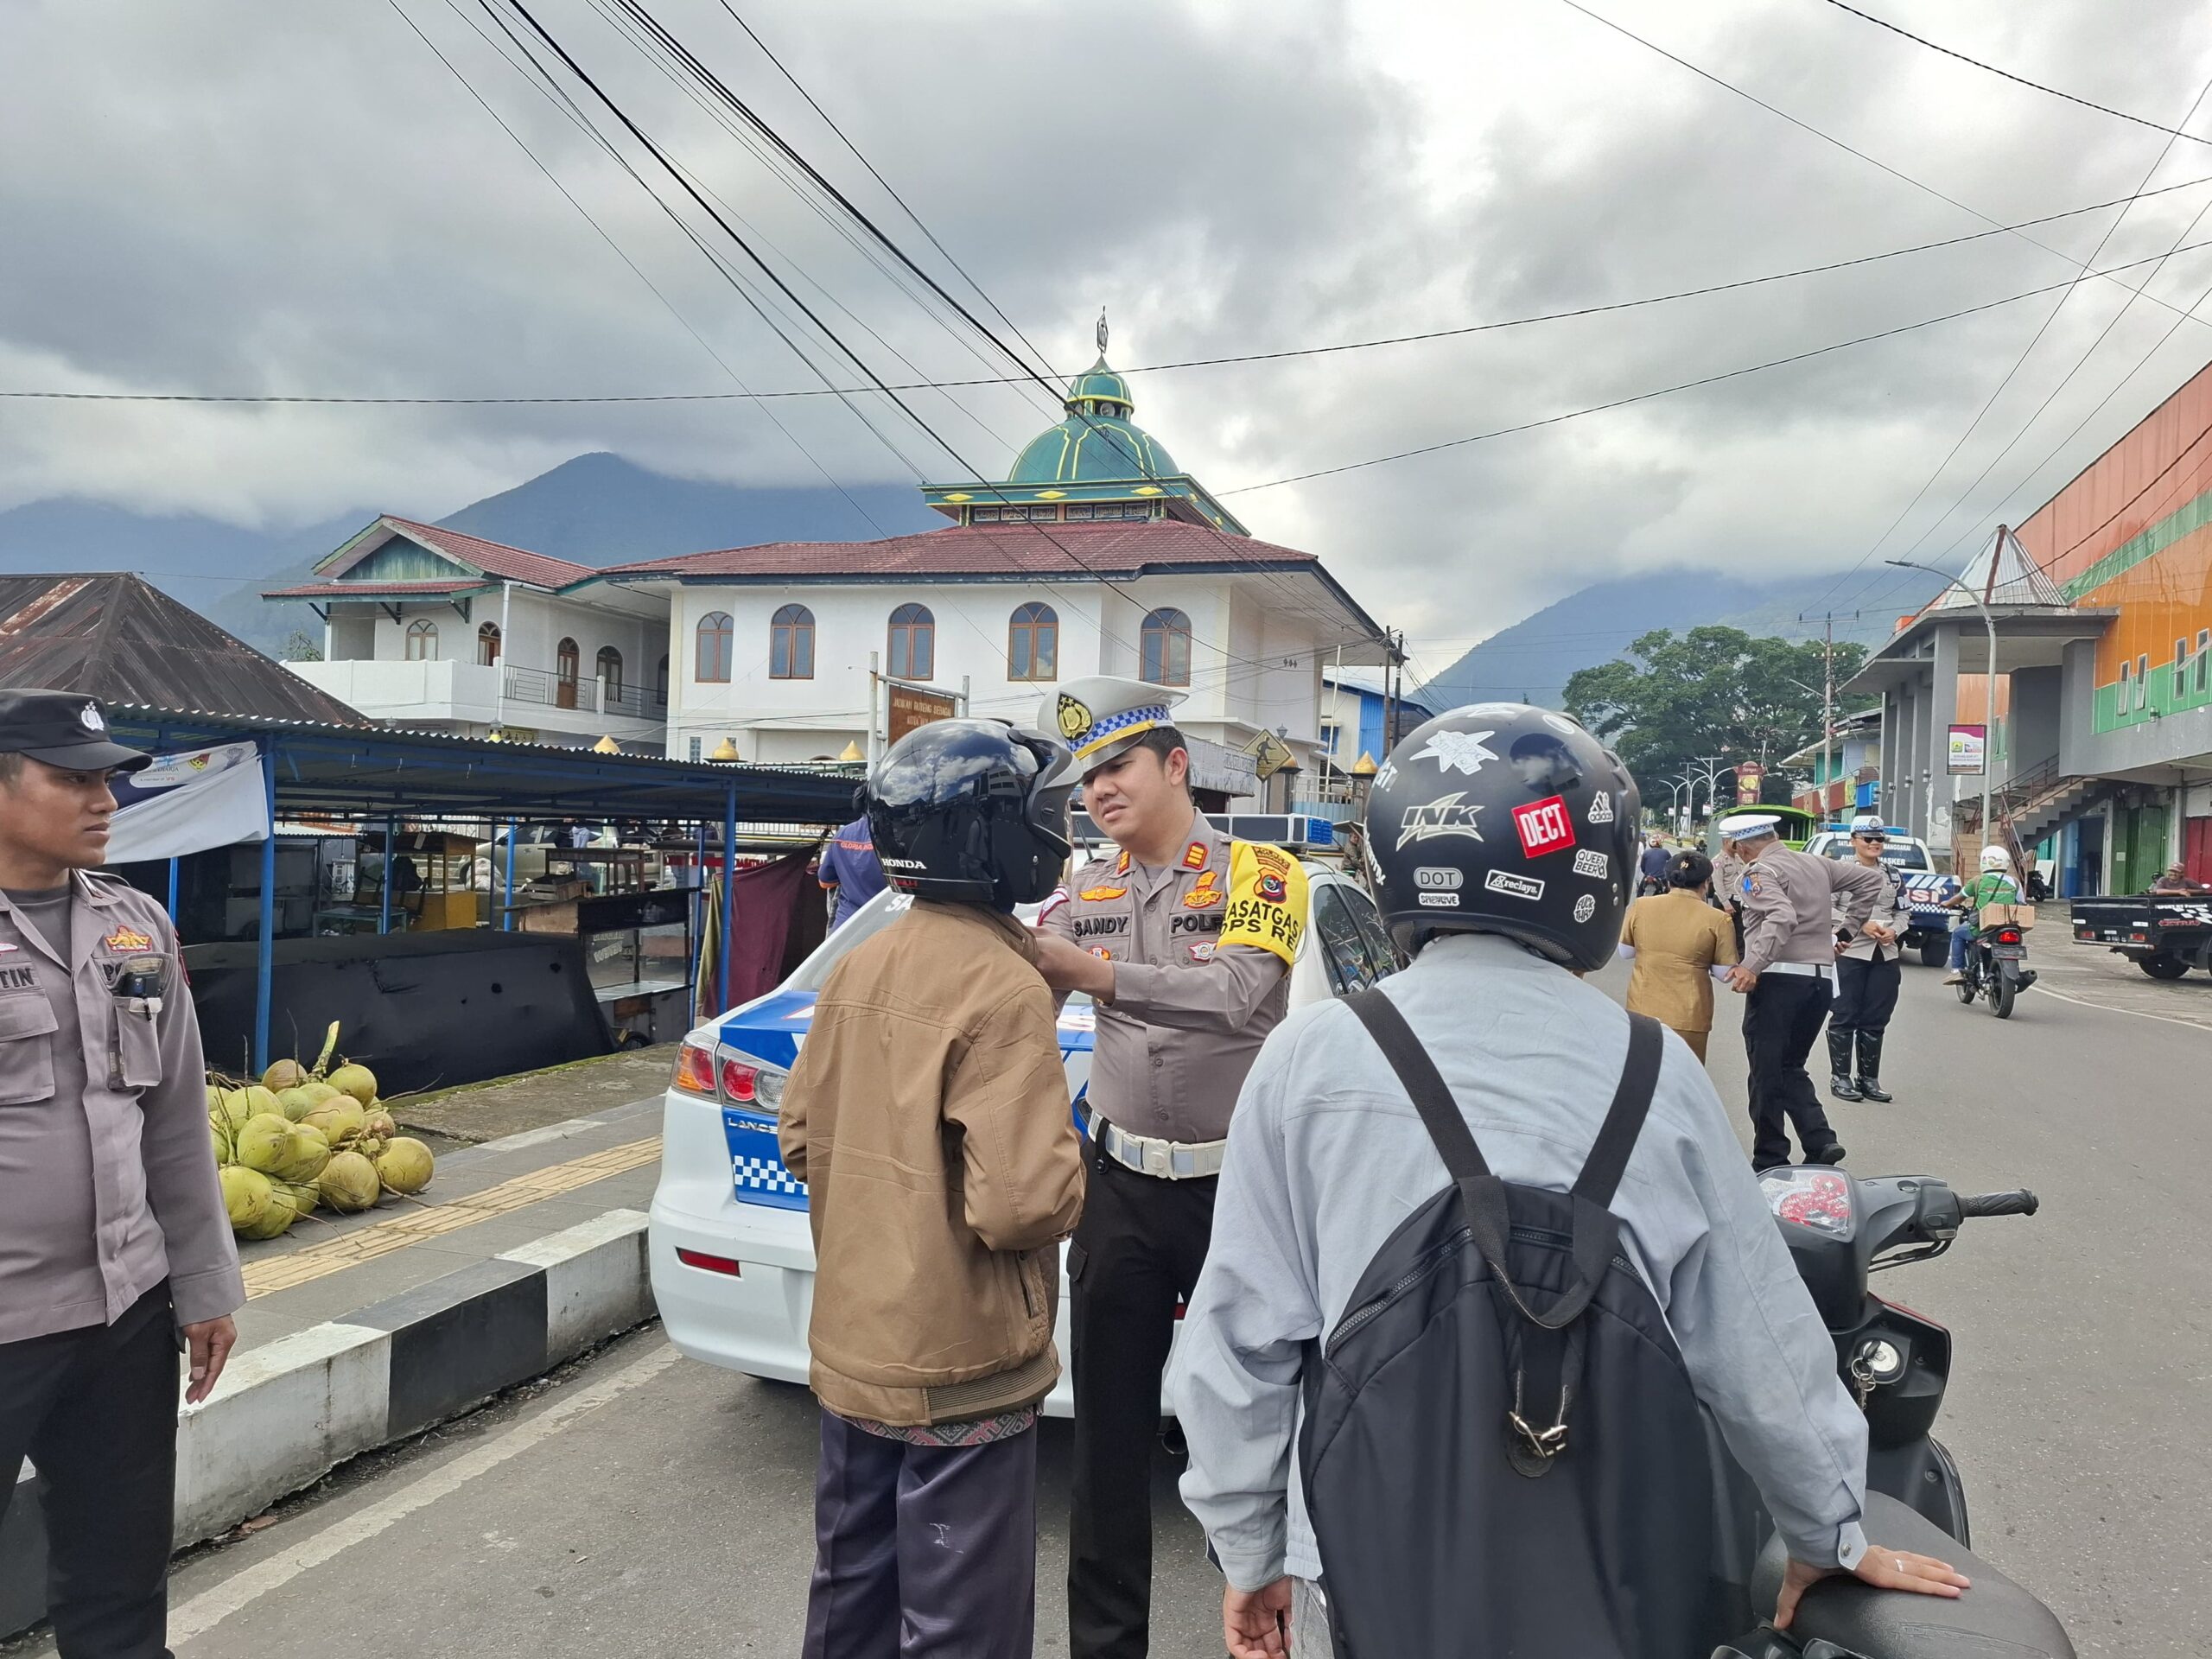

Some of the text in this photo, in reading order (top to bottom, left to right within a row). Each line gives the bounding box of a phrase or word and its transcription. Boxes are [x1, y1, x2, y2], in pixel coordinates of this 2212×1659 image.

[1519, 803, 1567, 848] DECT
[840, 842, 862, 850] GLORIA
[881, 858, 927, 870] HONDA
[1578, 850, 1607, 865] QUEEN
[1420, 872, 1456, 886] DOT
[1073, 916, 1128, 938] SANDY
